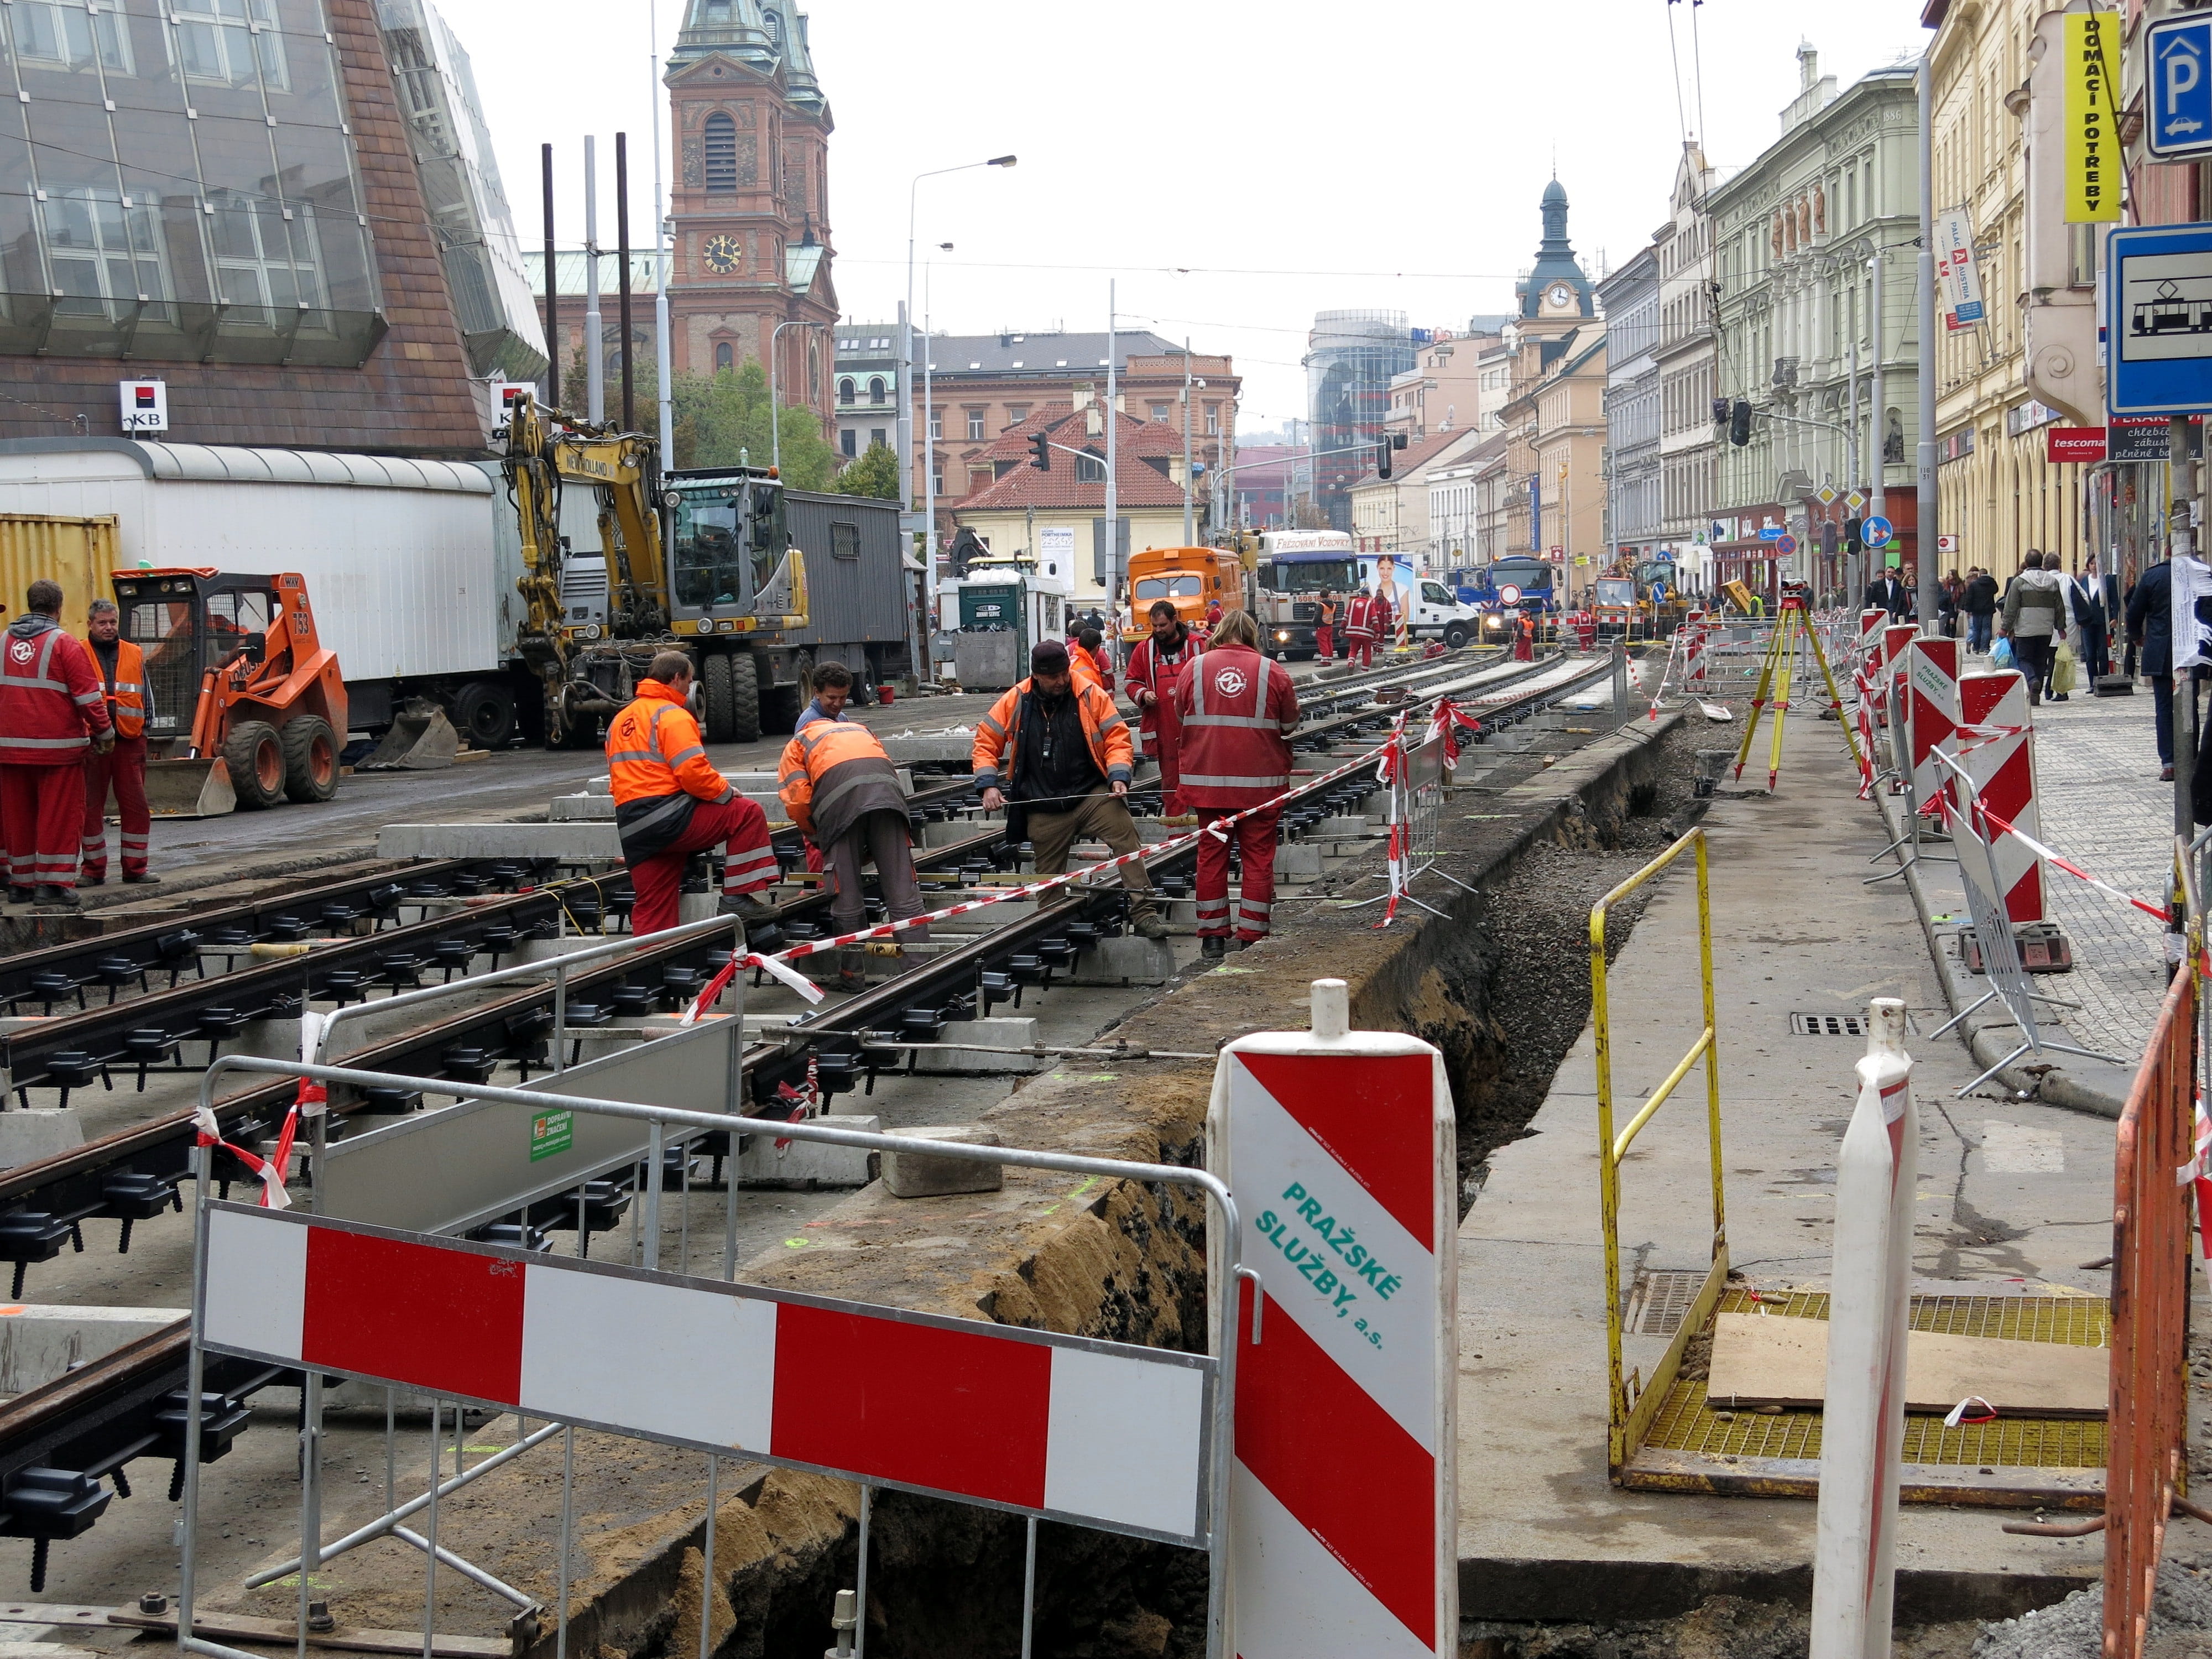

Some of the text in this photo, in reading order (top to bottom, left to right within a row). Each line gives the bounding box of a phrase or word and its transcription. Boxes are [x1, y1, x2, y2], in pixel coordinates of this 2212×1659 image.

[2083, 20, 2102, 106] DOMÁCÍ
[2167, 55, 2199, 115] P
[1883, 110, 1901, 122] 1886
[2084, 113, 2100, 212] POTŘEBY
[1950, 221, 1961, 248] PALÁC
[1958, 266, 1970, 300] AUSTRIA
[132, 414, 160, 425] KB
[2128, 427, 2170, 436] chlebíč
[2054, 439, 2105, 448] tescoma
[2135, 437, 2170, 446] zákusk
[2115, 448, 2152, 460] plněné
[566, 454, 607, 477] NEW HOLLAND
[1318, 536, 1350, 547] VOZOVKY
[285, 577, 299, 588] WAY
[293, 612, 309, 635] 753
[1922, 665, 1948, 690] PRAŽSKÉ
[547, 1111, 572, 1125] DOPRAVNÍ
[546, 1120, 567, 1136] ZNAČENÍ
[1282, 1181, 1403, 1301] PRAŽSKÉ
[1255, 1210, 1382, 1349] SLUŽBY, a.s.
